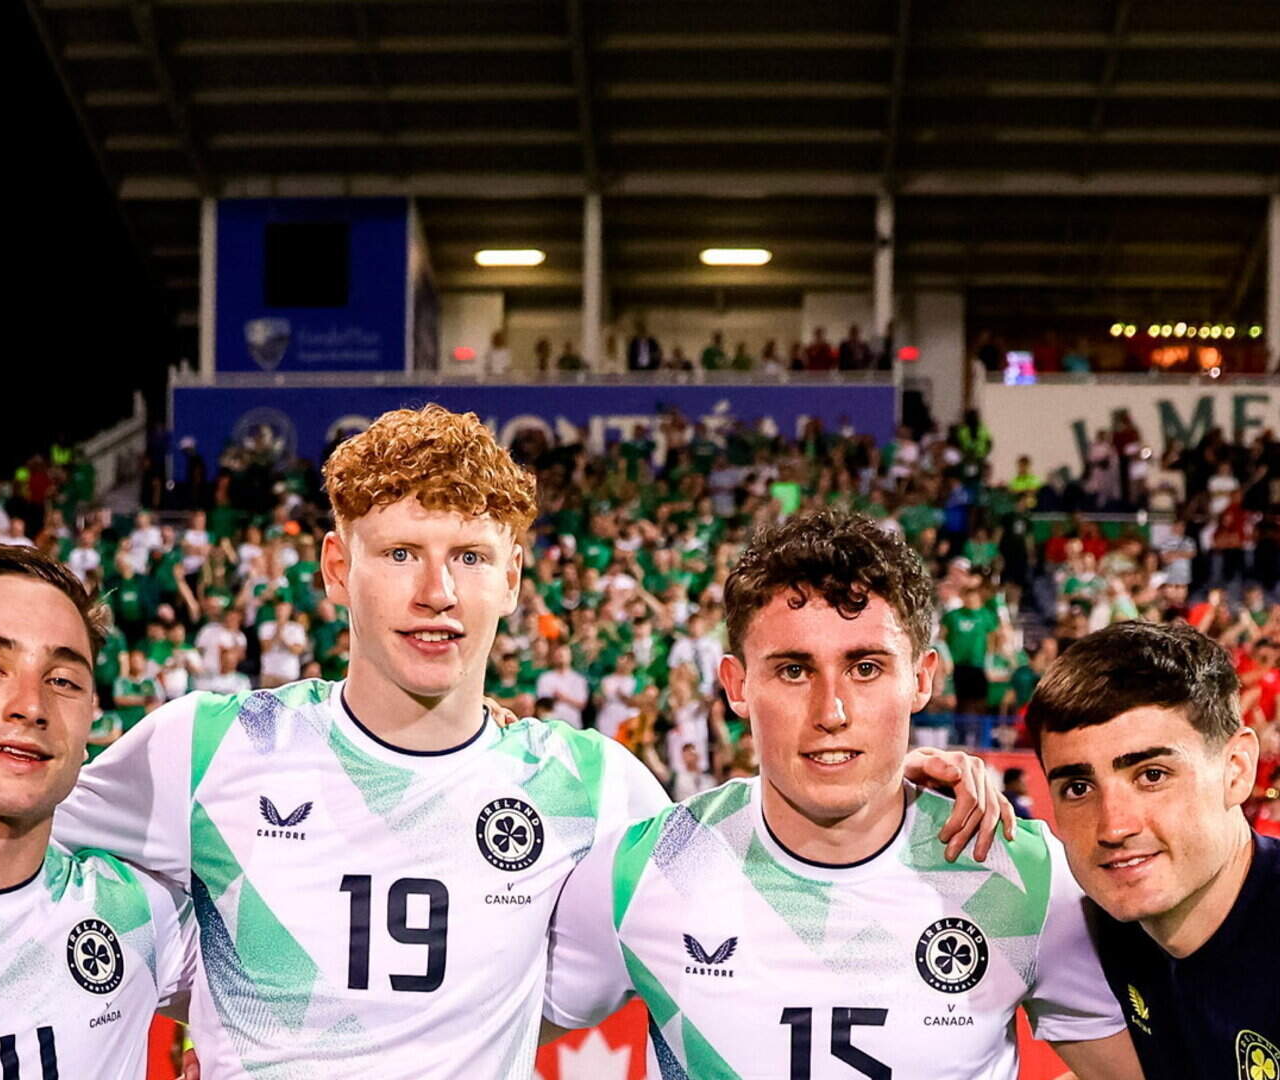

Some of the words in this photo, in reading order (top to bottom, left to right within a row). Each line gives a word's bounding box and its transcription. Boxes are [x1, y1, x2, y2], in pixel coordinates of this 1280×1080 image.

[480, 800, 540, 825] IRELAND
[257, 829, 306, 840] CASTORE
[484, 895, 532, 904] CANADA
[67, 921, 115, 950] IRELAND
[339, 874, 449, 992] 19
[920, 920, 983, 945] IRELAND
[685, 966, 735, 978] CASTORE
[89, 1010, 122, 1028] CANADA
[923, 1016, 975, 1026] CANADA
